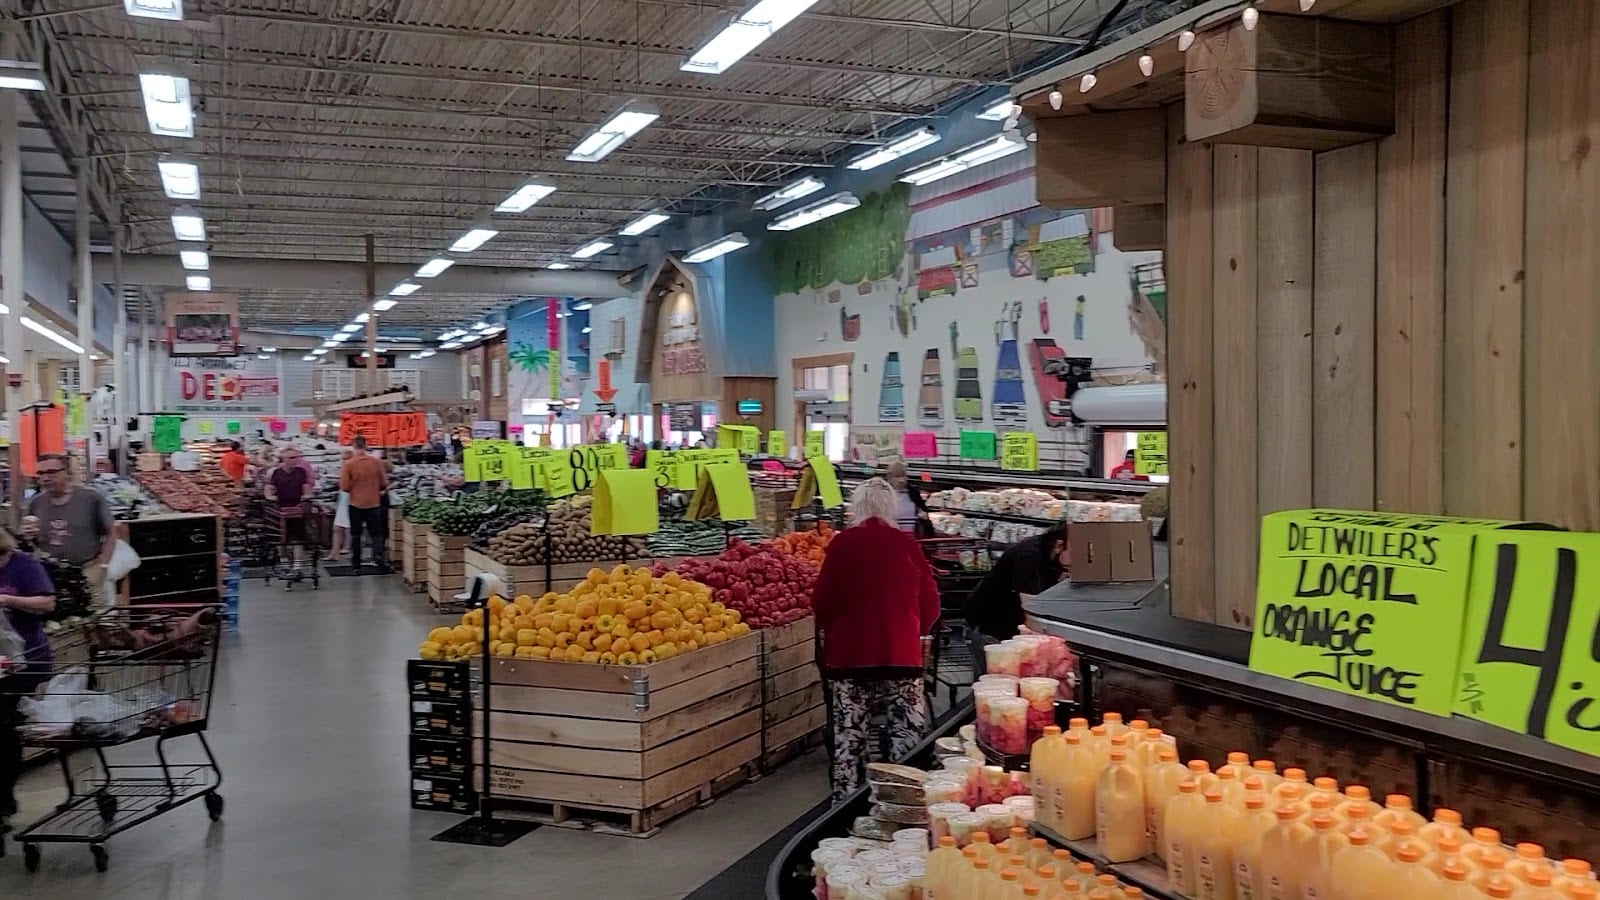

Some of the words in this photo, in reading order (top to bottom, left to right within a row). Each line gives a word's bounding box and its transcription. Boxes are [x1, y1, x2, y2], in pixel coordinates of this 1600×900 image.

[1287, 521, 1442, 566] DETWILER'S
[1293, 559, 1419, 606] LOCAL
[1262, 603, 1376, 657] ORANGE
[1292, 652, 1424, 705] JUICE
